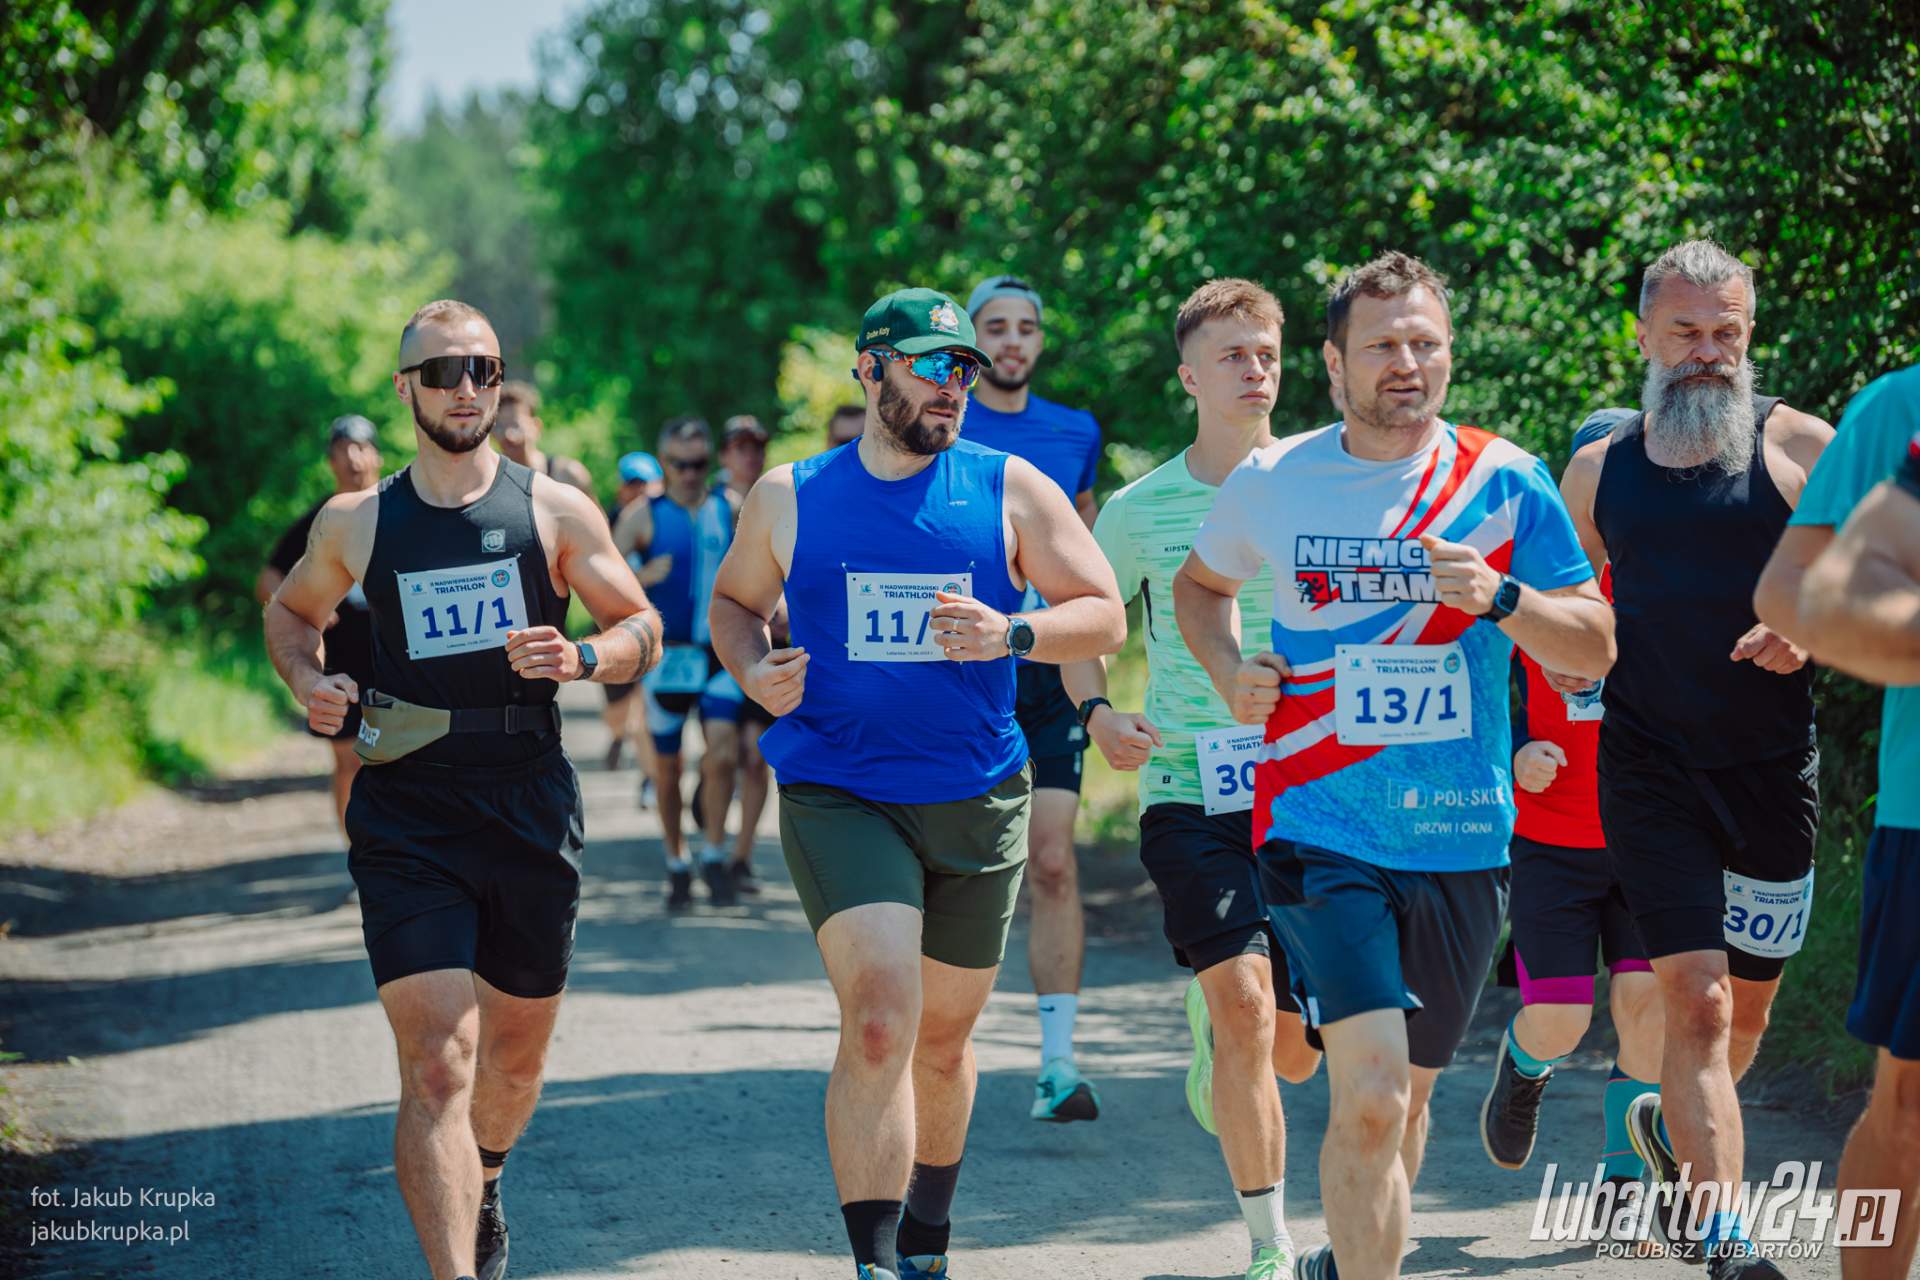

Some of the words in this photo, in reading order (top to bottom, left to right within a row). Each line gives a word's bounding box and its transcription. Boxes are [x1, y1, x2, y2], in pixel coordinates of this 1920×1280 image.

[1296, 535, 1431, 568] NIEMC
[435, 582, 486, 595] TRIATHLON
[884, 591, 935, 600] TRIATHLON
[1332, 570, 1442, 603] TEAM
[422, 597, 514, 639] 11/1
[865, 609, 931, 645] 11/
[1376, 666, 1436, 674] TRIATHLON
[1355, 684, 1457, 725] 13/1
[1414, 822, 1452, 834] DRZWI
[1462, 822, 1492, 834] OKNA
[1754, 895, 1799, 905] TRIATHLON
[1724, 905, 1804, 944] 30/1
